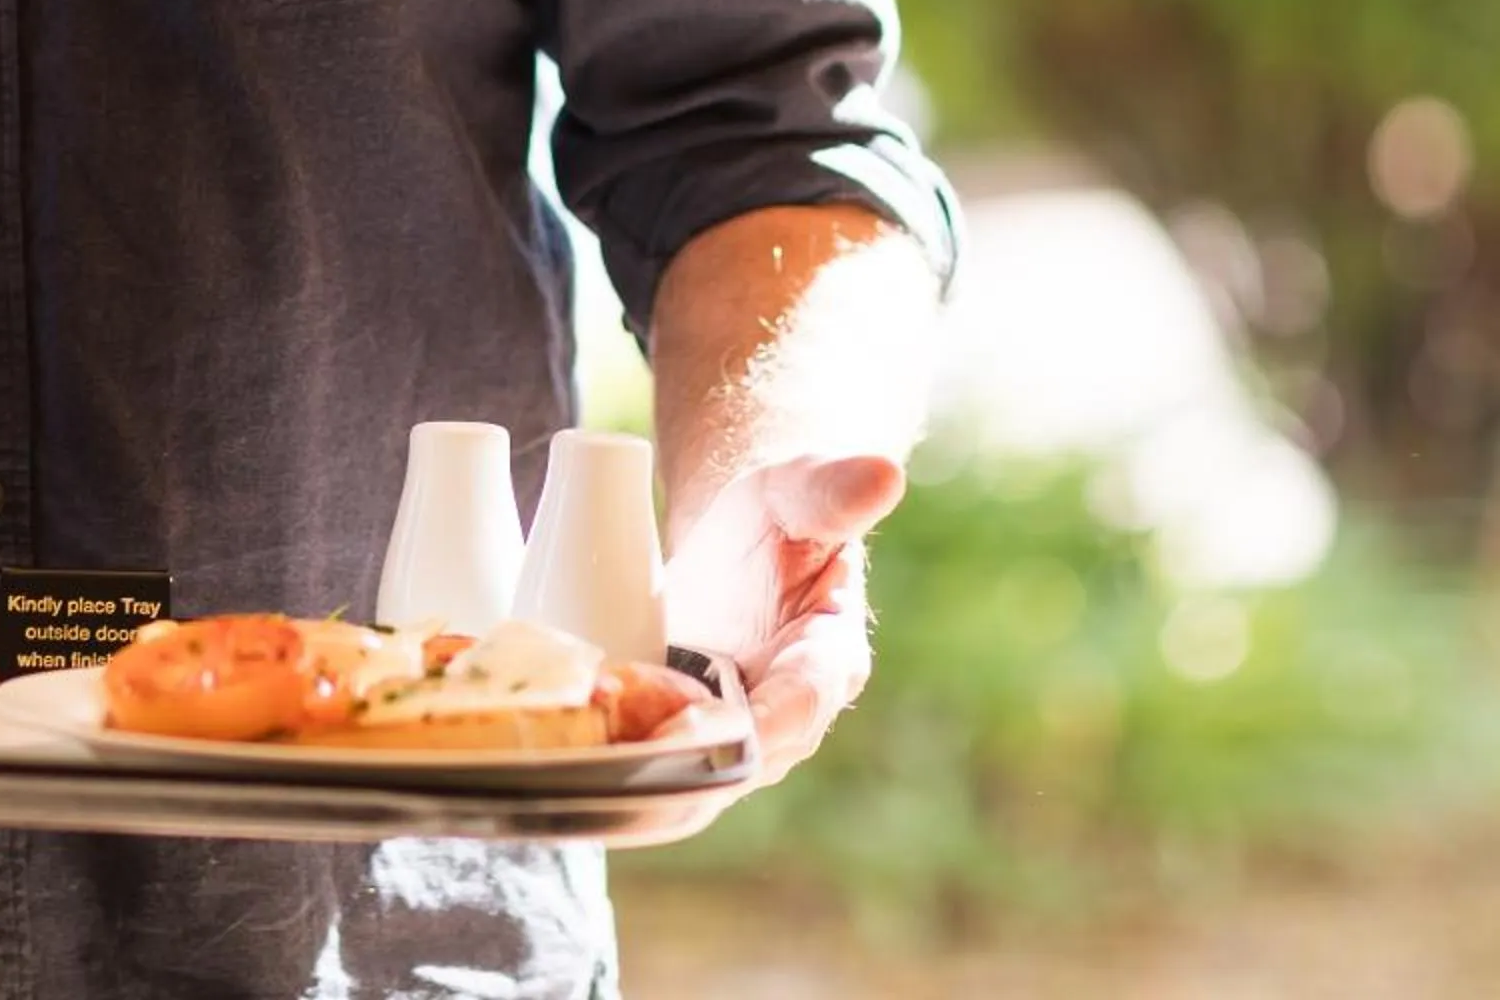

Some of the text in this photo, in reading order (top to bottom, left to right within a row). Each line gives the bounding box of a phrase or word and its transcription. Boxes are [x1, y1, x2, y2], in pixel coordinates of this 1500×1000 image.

[7, 595, 161, 618] Kindly place Tray
[25, 625, 90, 641] outside
[17, 652, 66, 668] when
